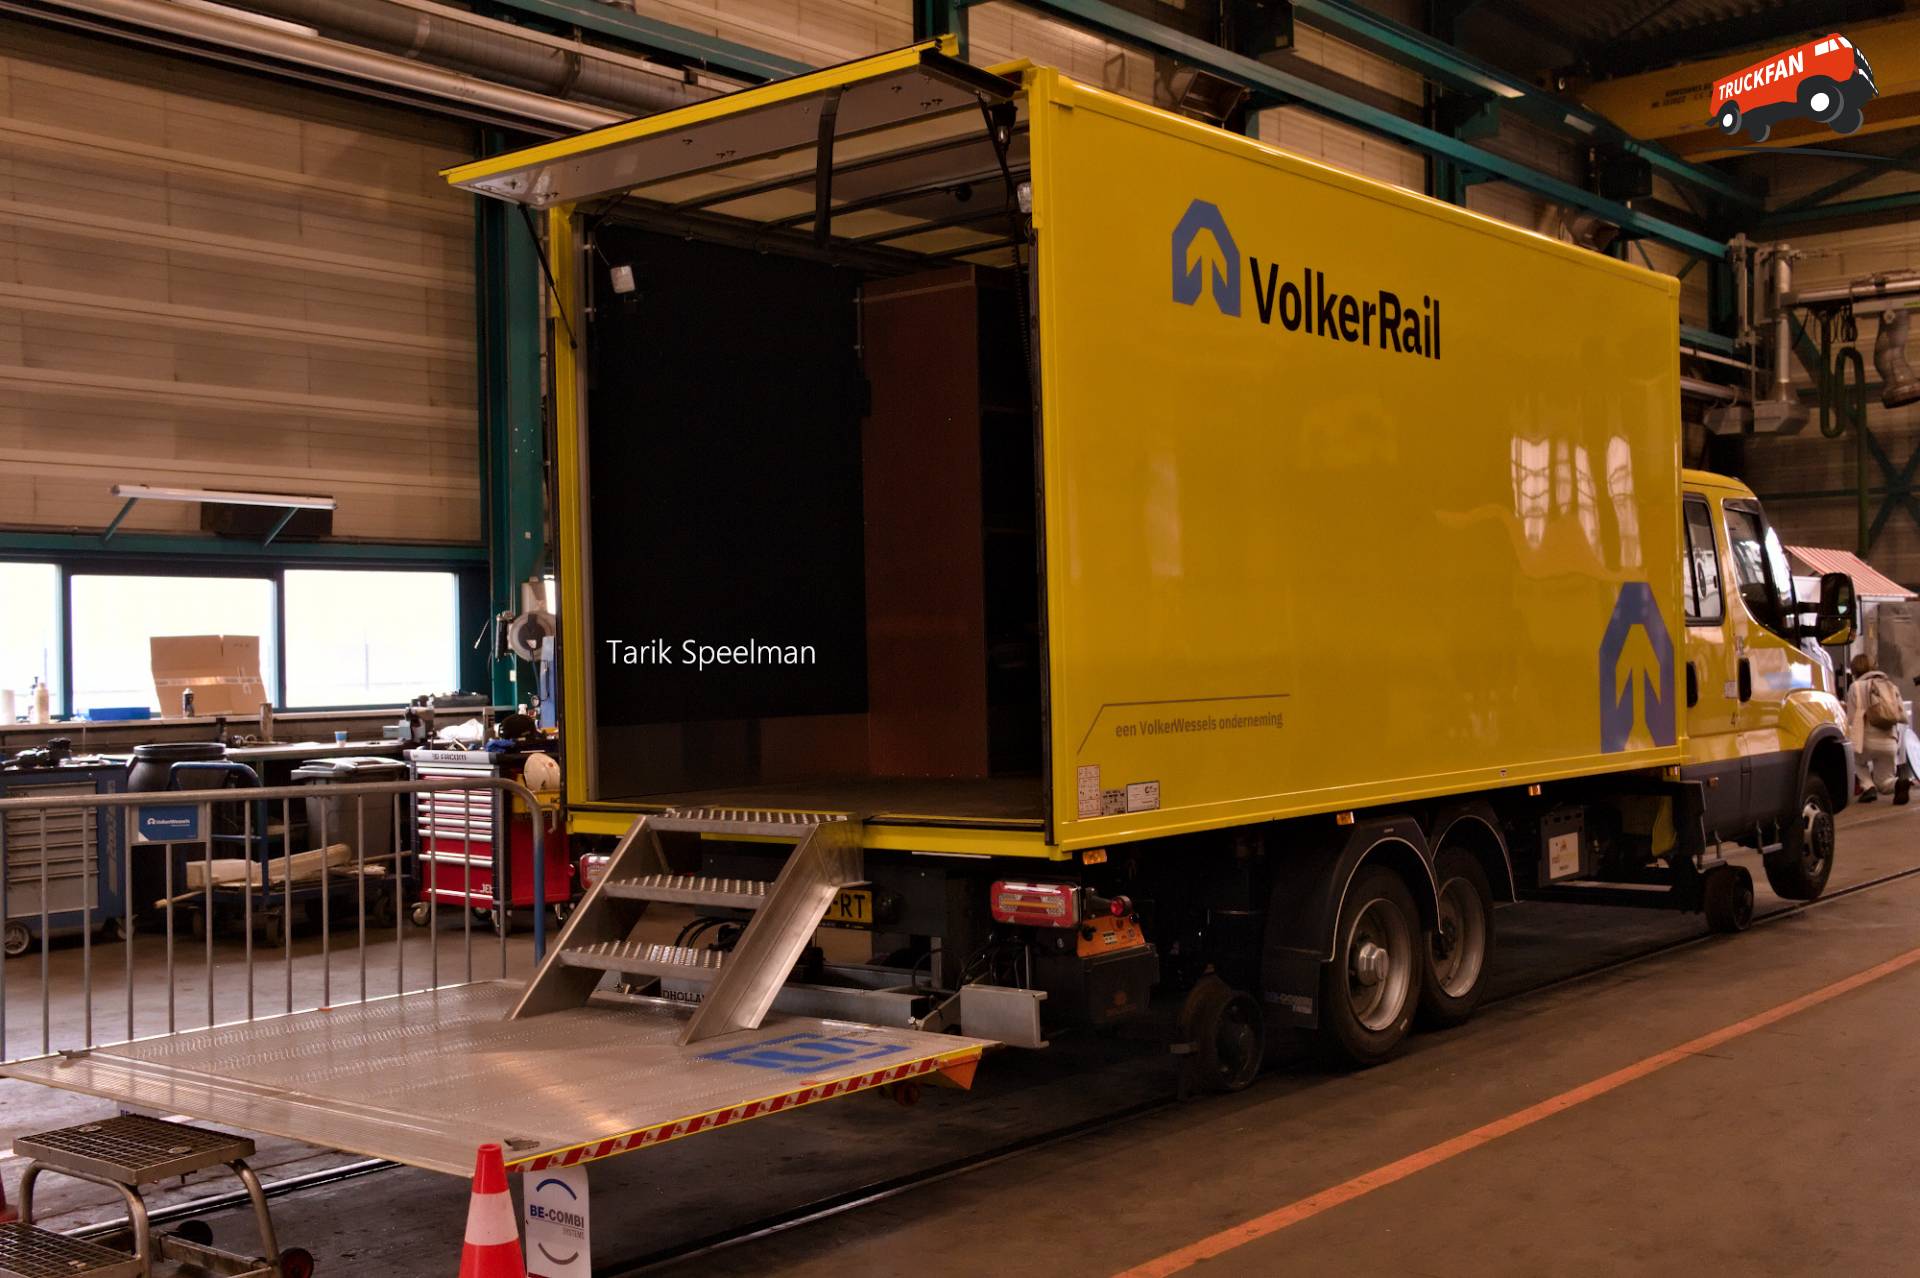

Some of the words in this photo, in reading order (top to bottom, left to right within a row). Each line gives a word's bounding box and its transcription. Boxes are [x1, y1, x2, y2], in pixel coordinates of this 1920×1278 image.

[1249, 256, 1441, 360] VolkerRail
[1116, 722, 1137, 737] een
[1140, 715, 1217, 735] VolkerWessels
[1219, 712, 1284, 732] onderneming
[530, 1204, 585, 1229] BE-COMBI
